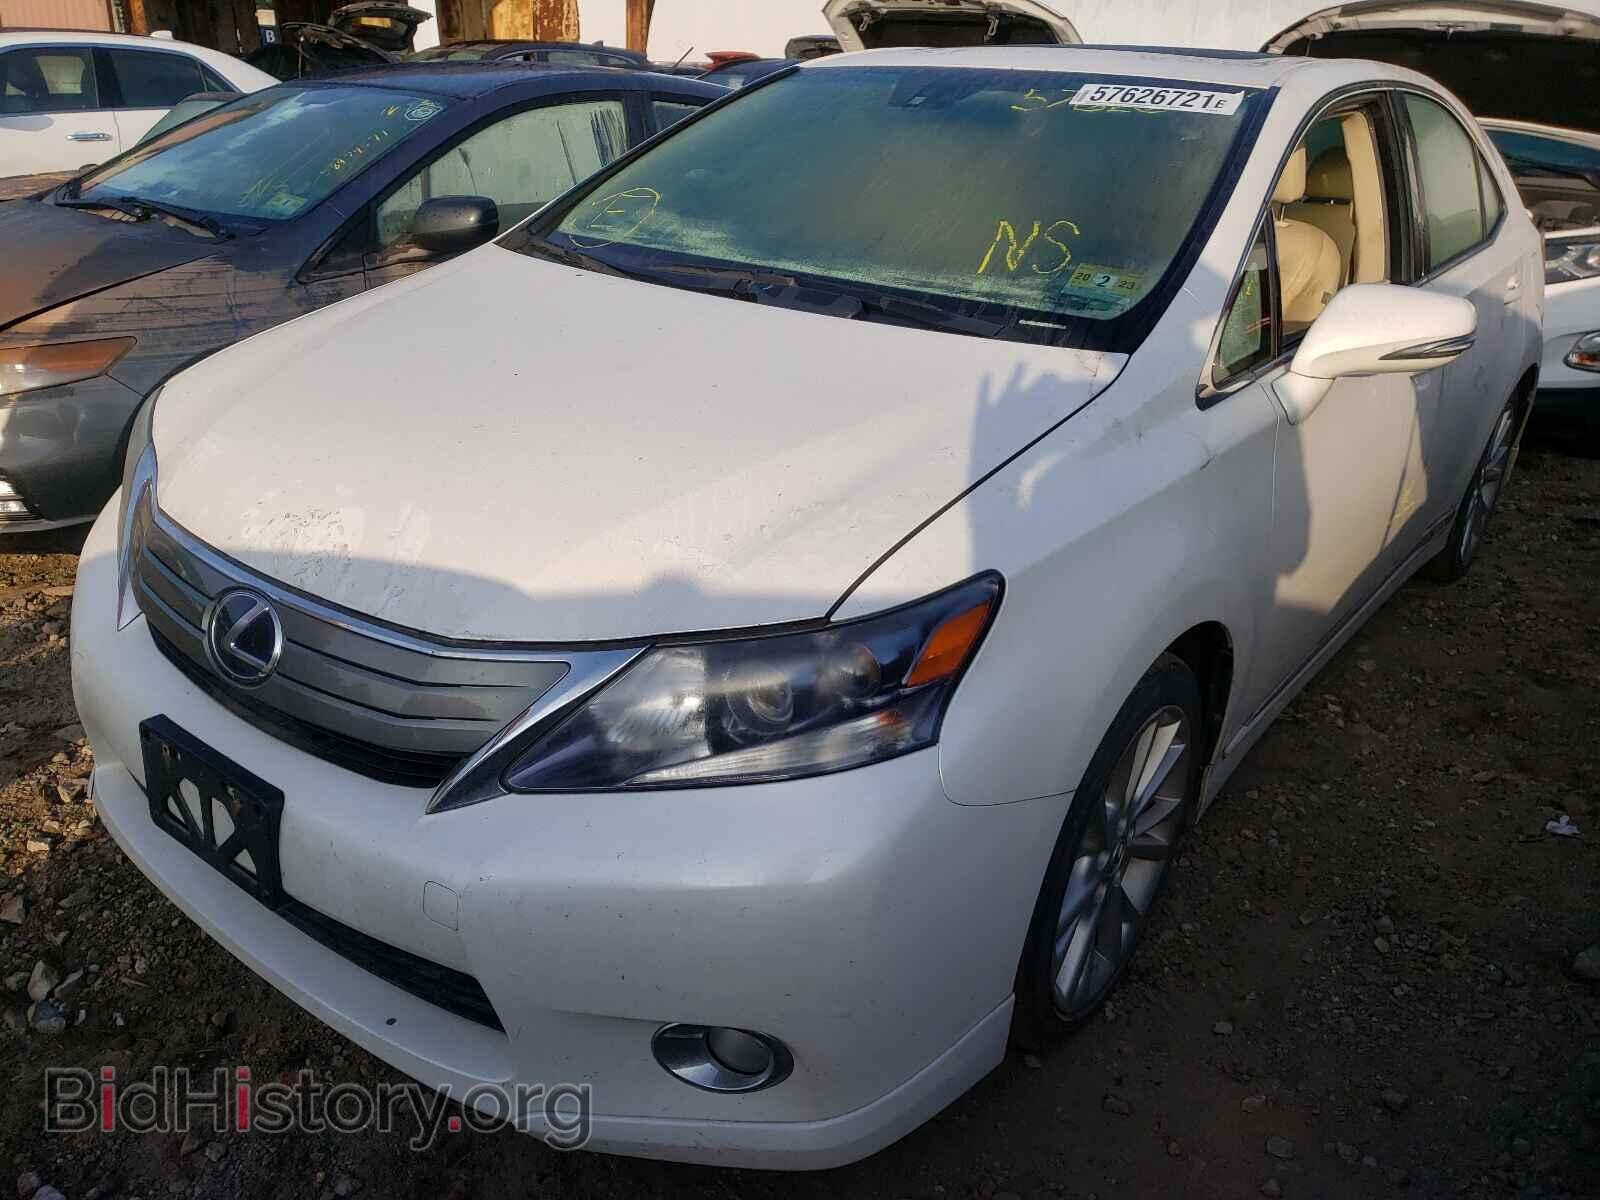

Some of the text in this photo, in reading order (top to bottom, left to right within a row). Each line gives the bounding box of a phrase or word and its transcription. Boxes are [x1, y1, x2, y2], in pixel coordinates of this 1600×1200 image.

[1089, 85, 1216, 110] 57626721
[976, 220, 1080, 275] NS
[1096, 275, 1111, 288] 2
